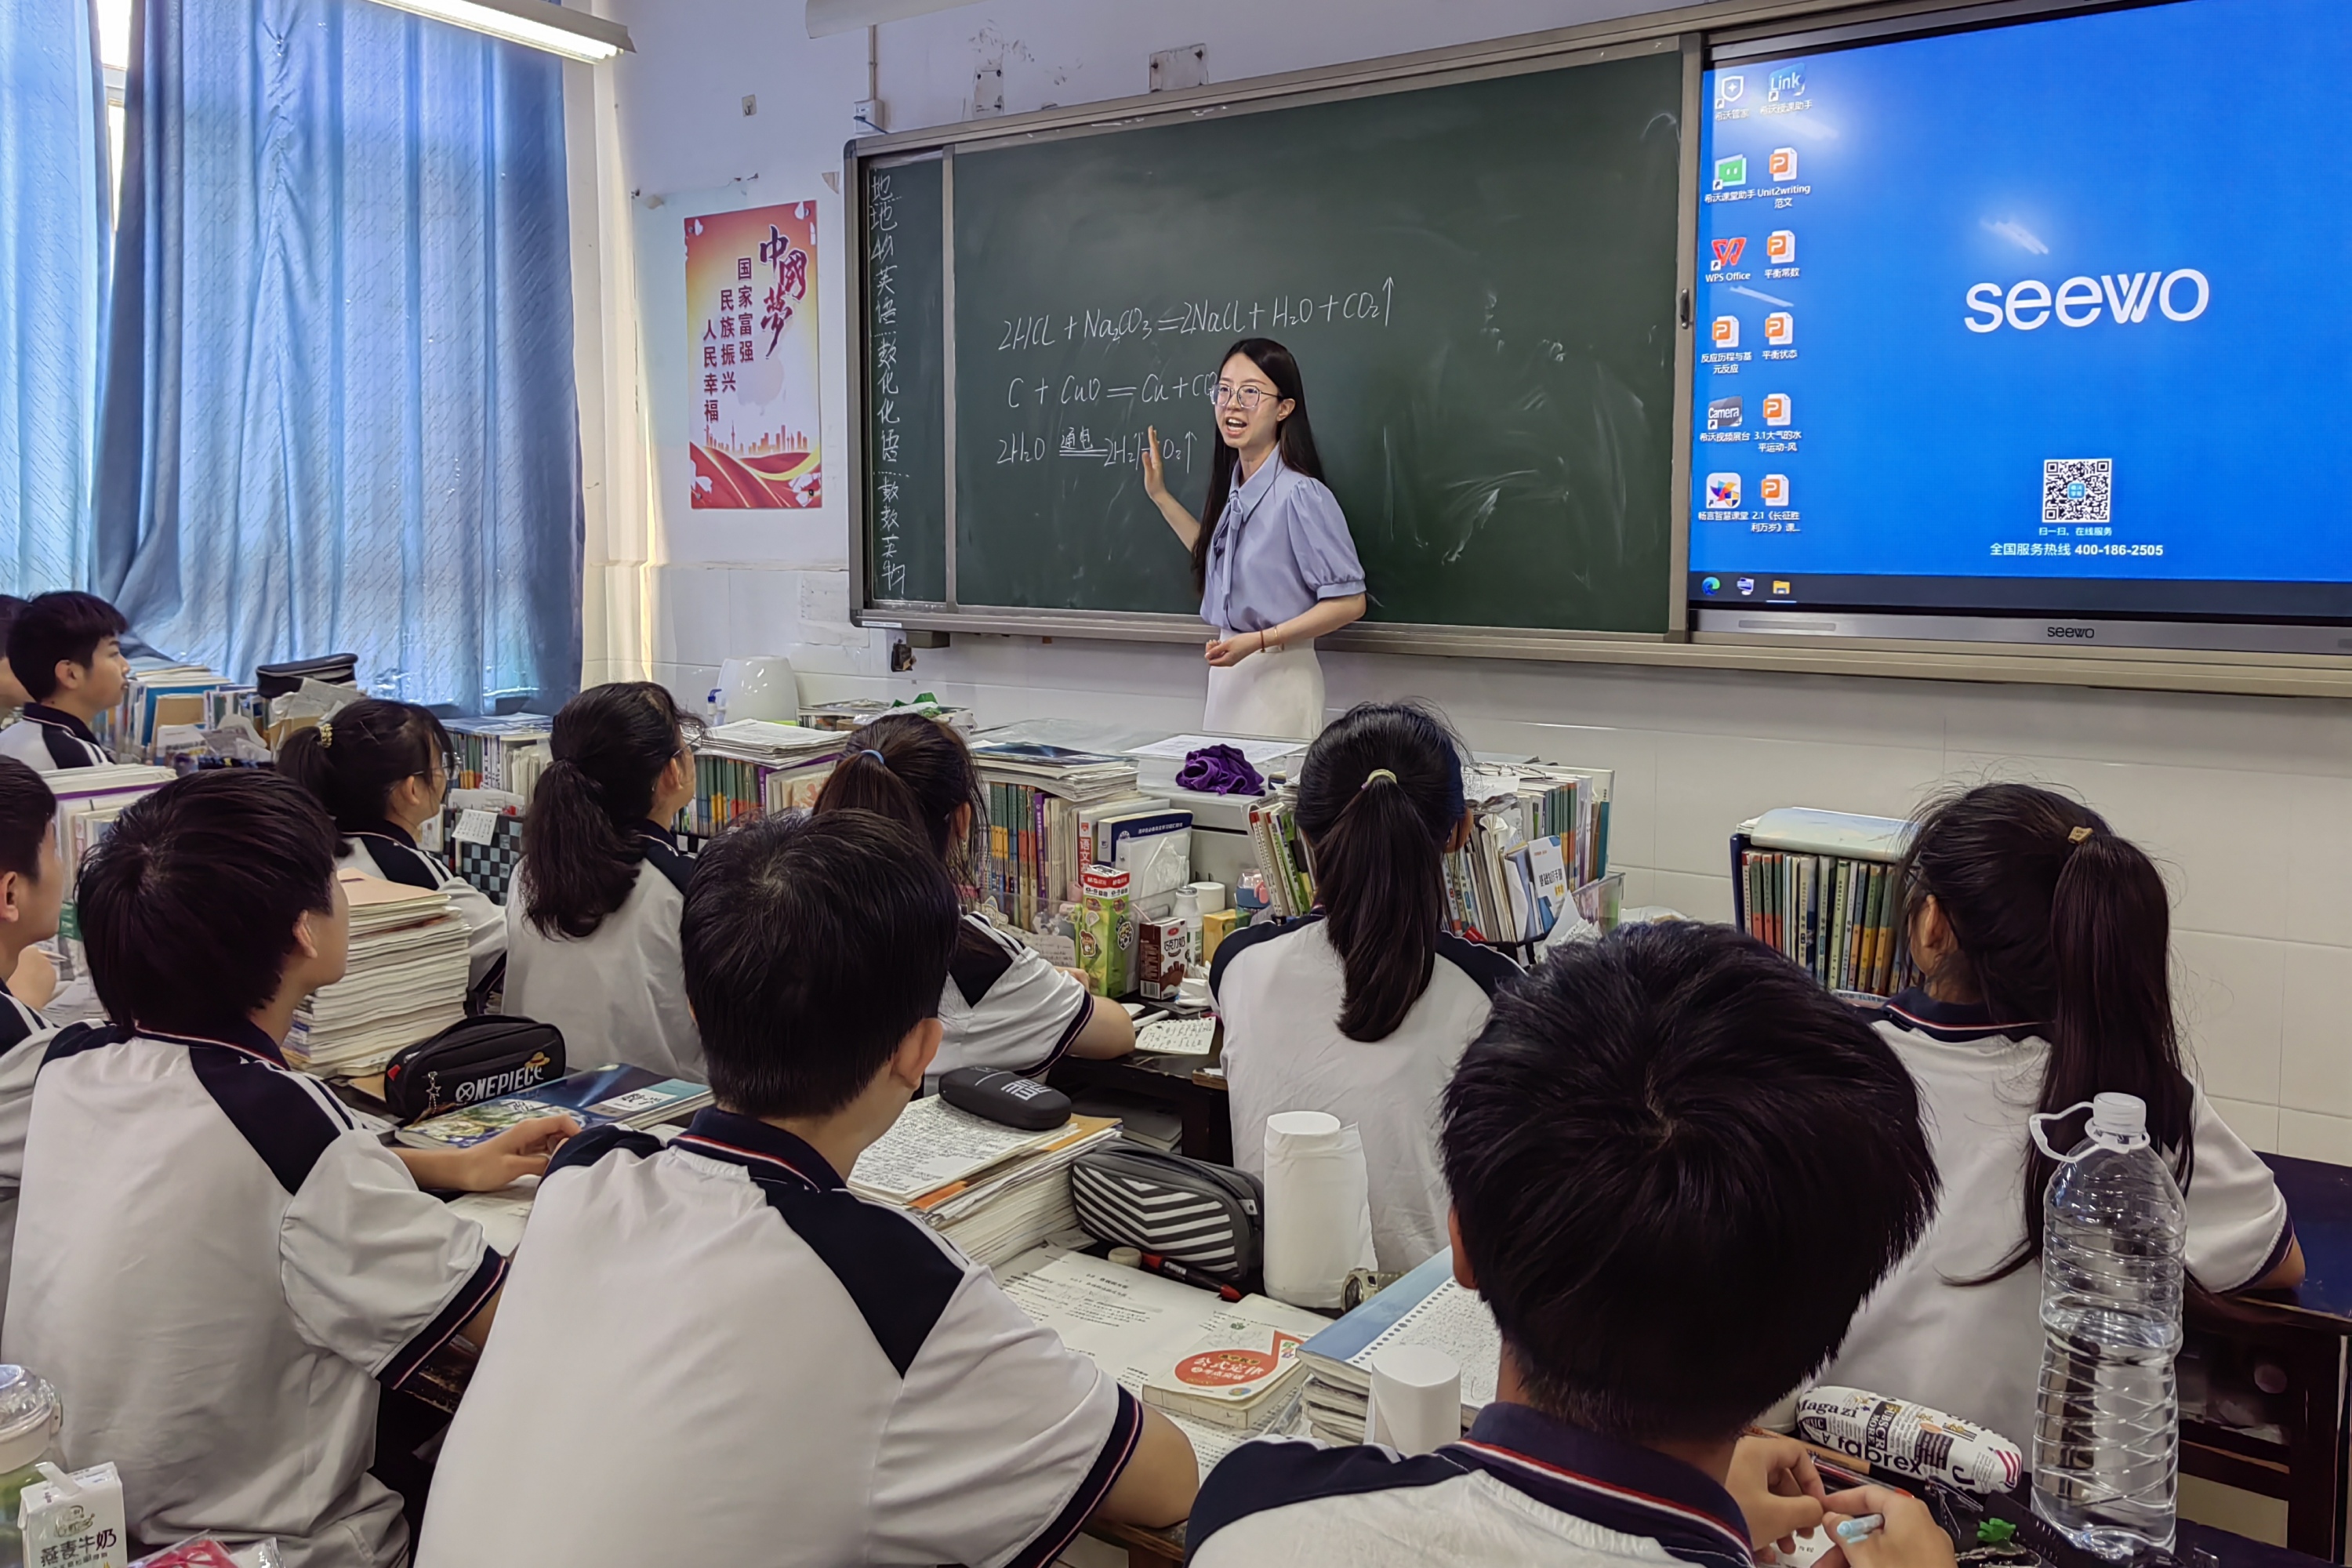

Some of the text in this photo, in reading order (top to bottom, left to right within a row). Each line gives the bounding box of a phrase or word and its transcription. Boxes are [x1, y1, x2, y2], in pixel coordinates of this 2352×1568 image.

[1771, 71, 1801, 91] Link
[1757, 185, 1811, 198] Unit2writing
[1774, 198, 1793, 209] 范文
[1705, 271, 1751, 282] WPS Office
[1764, 268, 1800, 279] 平衡常数
[1964, 268, 2209, 333] seewo
[737, 257, 753, 363] 国家富强
[720, 289, 735, 393] 民族振兴
[1700, 352, 1752, 363] 反应历程与基
[1762, 350, 1798, 360] 平衡状态
[702, 318, 719, 423] 人民幸福
[1713, 364, 1739, 374] 元反应
[1708, 406, 1740, 419] Camera
[1700, 432, 1750, 442] 希沃视频展台
[1758, 442, 1798, 452] 平运动-风
[1698, 511, 1749, 521] 畅言智慧课堂
[1990, 543, 2163, 556] 全国服务热线 400-186-2505
[2047, 626, 2095, 638] seewo
[40, 1528, 117, 1567] 燕麦牛奶
